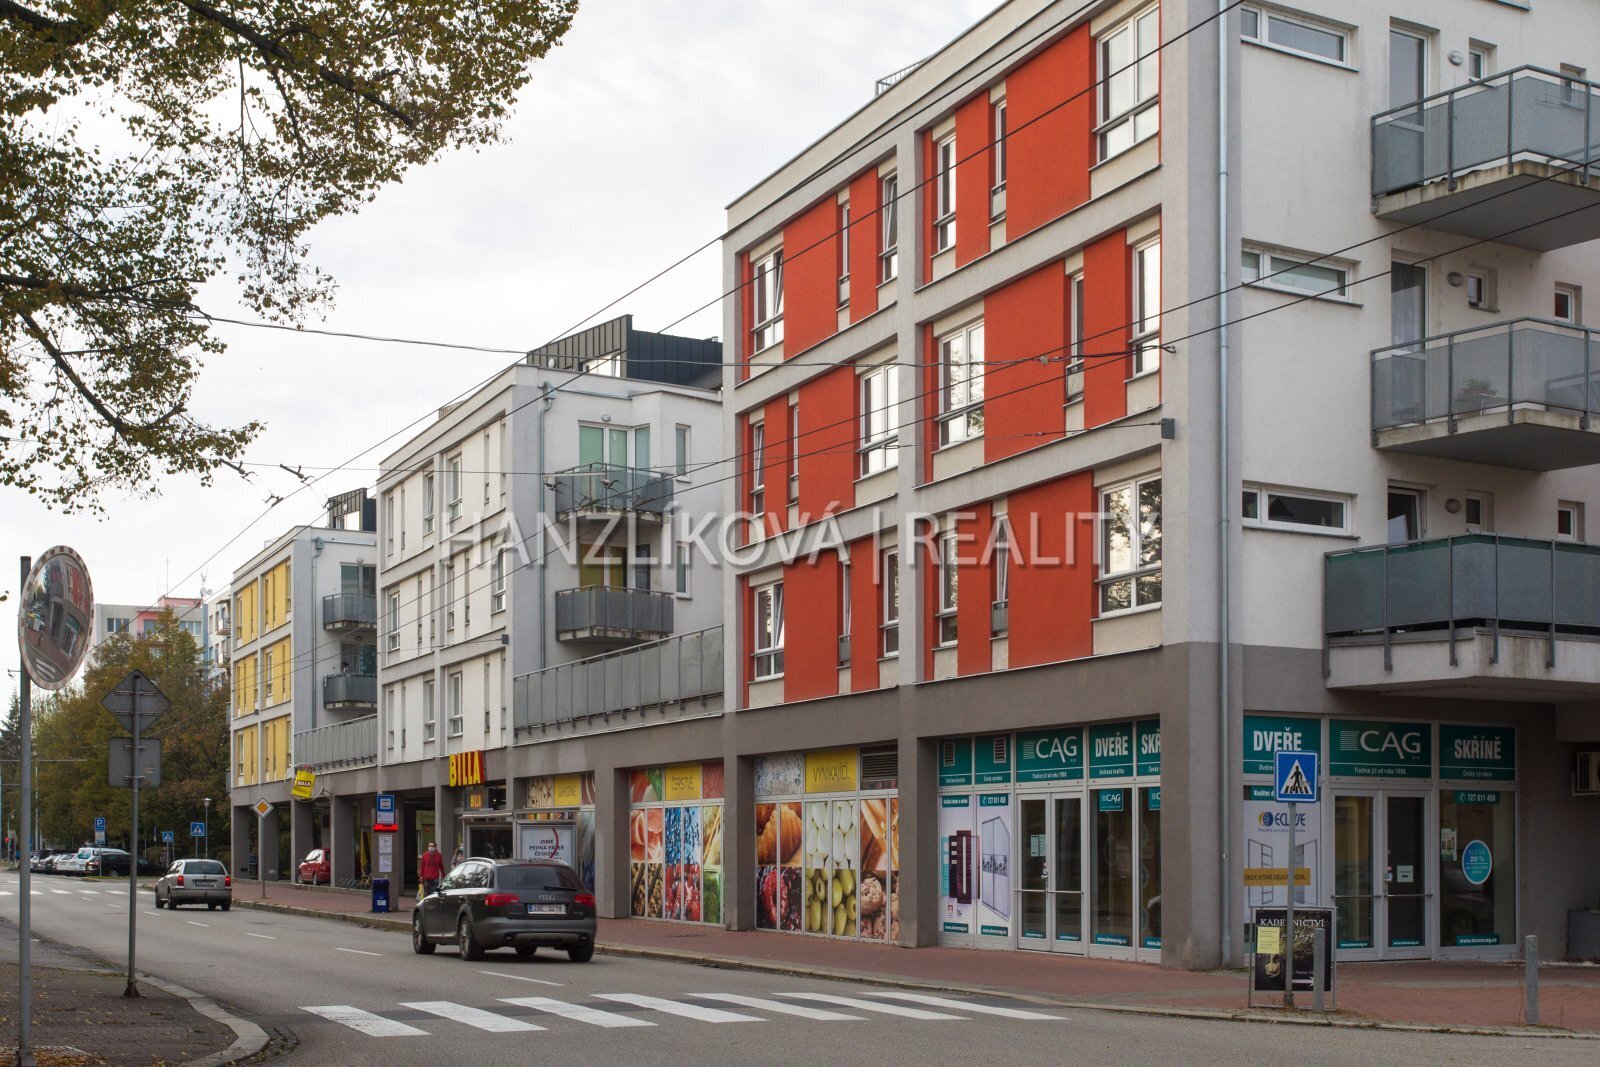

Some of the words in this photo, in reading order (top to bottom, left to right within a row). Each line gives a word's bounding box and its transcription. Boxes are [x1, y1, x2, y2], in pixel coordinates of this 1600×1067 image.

[1036, 736, 1078, 763] CAG
[1095, 731, 1129, 758] DVEŘE
[1253, 726, 1302, 752] DVEŘE
[1360, 730, 1421, 760] CAG
[1454, 735, 1502, 760] SKŘÍNĚ
[449, 750, 482, 788] BILLA
[1106, 793, 1121, 803] CAG
[1260, 918, 1325, 927] KADENICTVÍ
